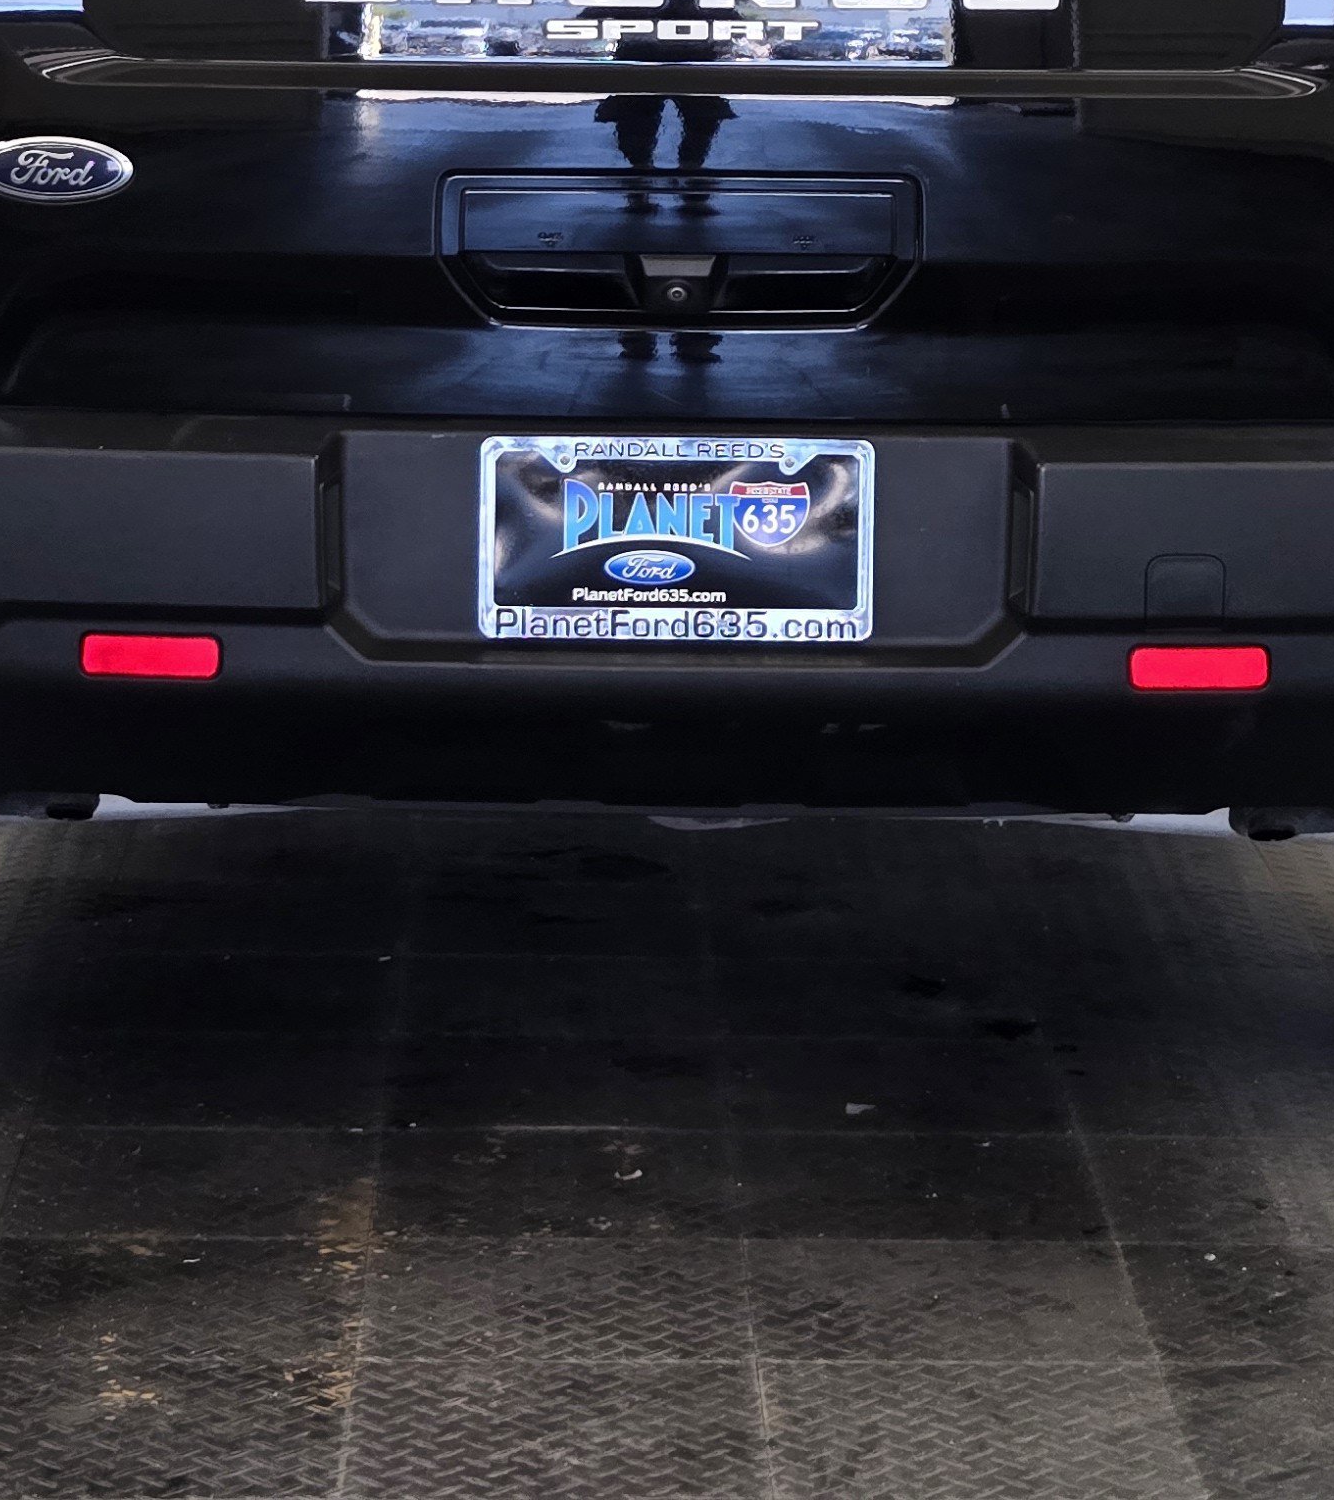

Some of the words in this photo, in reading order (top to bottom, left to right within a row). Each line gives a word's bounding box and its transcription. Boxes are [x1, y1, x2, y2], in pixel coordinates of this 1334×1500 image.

[544, 18, 821, 42] SPORT
[10, 149, 96, 187] Ford
[574, 442, 689, 458] RANDALL
[697, 443, 785, 459] REED'S
[563, 478, 741, 551] PLANET
[742, 504, 797, 535] 635
[622, 555, 677, 581] Ford
[572, 587, 727, 603] PlanetFord635.com
[495, 608, 858, 639] PlanetFord635.com
